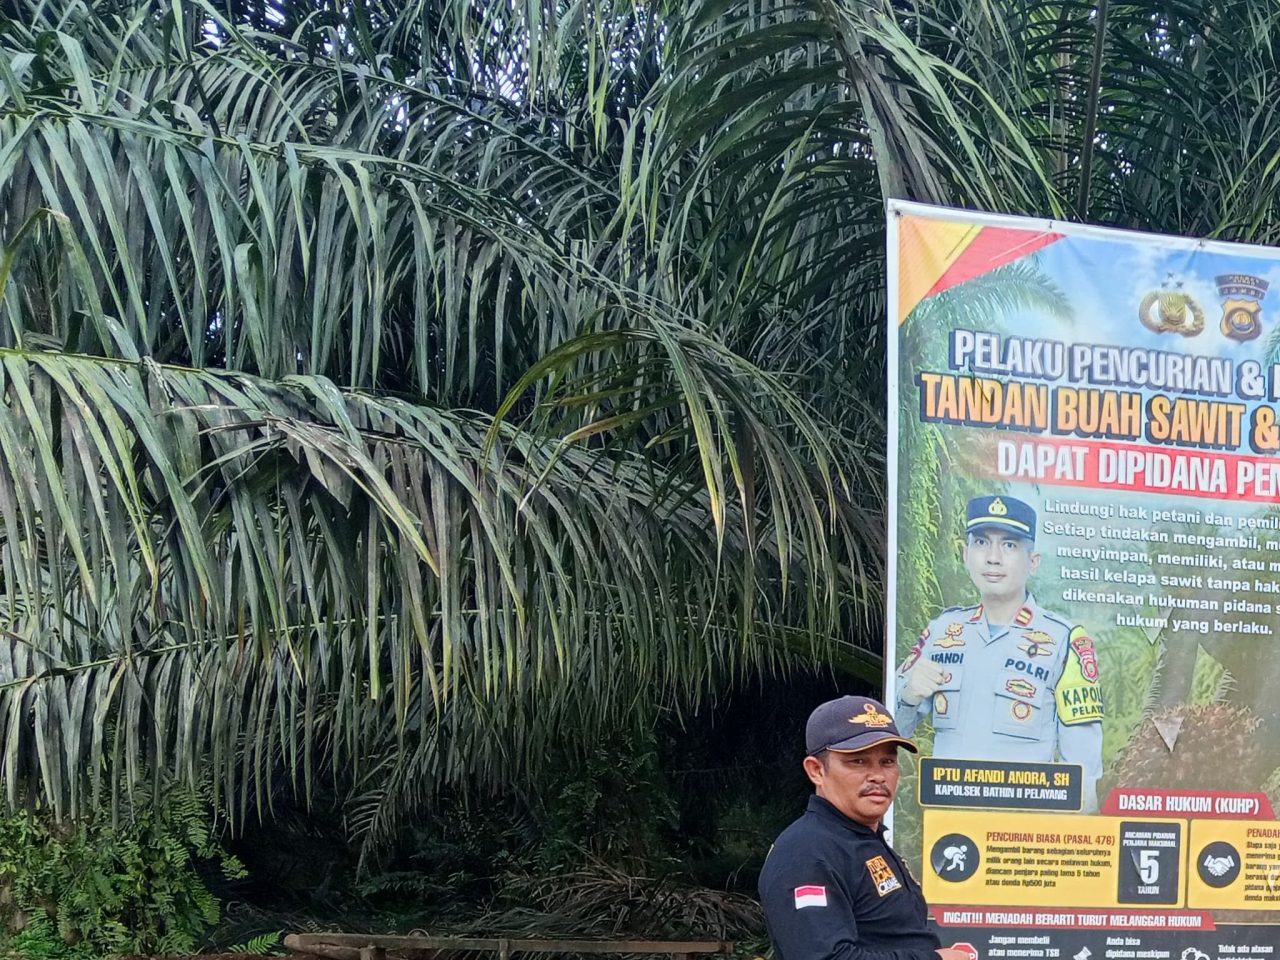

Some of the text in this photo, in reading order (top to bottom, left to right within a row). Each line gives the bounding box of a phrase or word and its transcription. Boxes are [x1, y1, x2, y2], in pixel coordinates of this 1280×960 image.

[953, 328, 1063, 378] PELAKU
[1072, 344, 1232, 396] PENCURIAN
[1238, 360, 1266, 398] &
[920, 373, 1048, 430] TANDAN
[1057, 387, 1142, 438] BUAH
[1150, 396, 1246, 449] SAWIT
[1254, 405, 1280, 451] &
[1000, 440, 1089, 481] DAPAT
[1099, 448, 1227, 495] DIPIDANA
[1045, 499, 1114, 519] Lindungi
[1119, 505, 1147, 520] hak
[1152, 509, 1200, 523] petani
[1205, 513, 1232, 526] dan
[1043, 521, 1095, 539] Setiap
[1100, 525, 1168, 542] tindakan
[1174, 533, 1262, 551] mengambil,
[1057, 546, 1153, 565] menyimpan,
[1158, 553, 1228, 570] memiliki,
[1232, 558, 1265, 570] atau
[1061, 567, 1099, 581] hasil
[1105, 569, 1155, 586] kelapa
[1161, 575, 1202, 588] sawit
[1207, 577, 1250, 592] tanpa
[1255, 580, 1280, 593] hak
[1063, 588, 1144, 605] dikenakan
[1149, 594, 1218, 610] hukuman
[1224, 599, 1271, 614] pidana
[1116, 614, 1272, 635] hukum yang berlaku.
[1005, 658, 1050, 682] POLRI
[933, 768, 1070, 787] IPTU AFANDI ANORA, SH
[935, 784, 980, 797] KAPOLSEK
[983, 787, 1014, 798] BATHIN
[1025, 788, 1067, 800] PELAYANG
[1119, 795, 1259, 815] DASAR HUKUM (KUHP)
[986, 832, 1034, 842] PENCURIAN
[1036, 834, 1060, 844] BIASA
[1063, 834, 1092, 845] (PASAL
[1095, 835, 1115, 846] 476)
[1139, 849, 1159, 884] 5
[1137, 886, 1159, 895] TAHUN
[943, 912, 1202, 927] INGAT!!! MENADAH BERARTI TURUT MELANGGAR HUKUM
